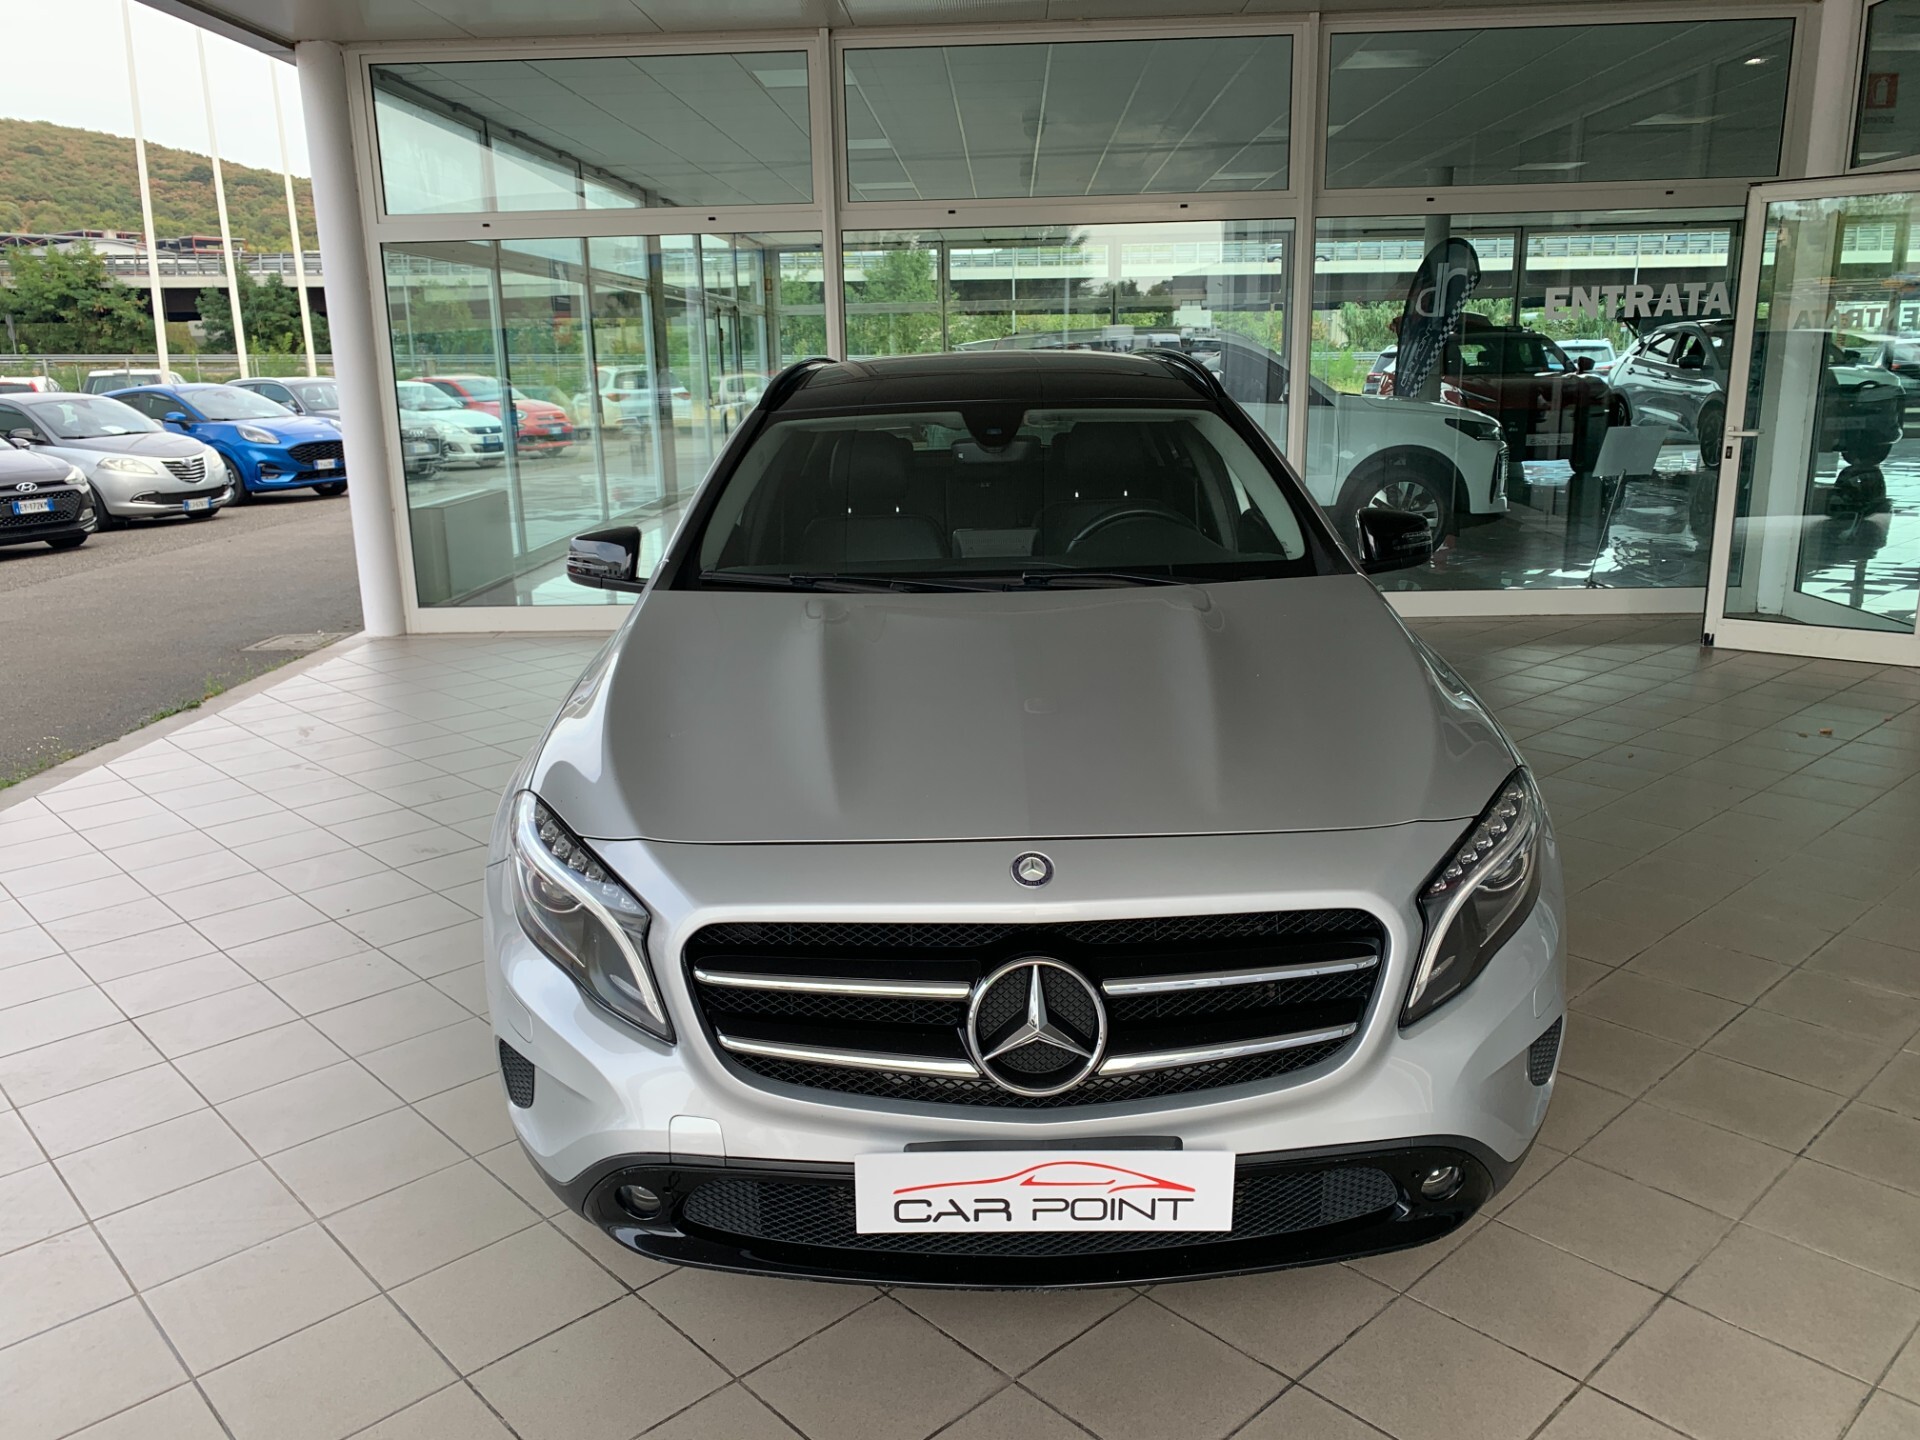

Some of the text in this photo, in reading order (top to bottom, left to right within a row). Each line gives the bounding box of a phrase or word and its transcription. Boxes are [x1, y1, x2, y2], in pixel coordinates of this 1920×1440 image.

[1544, 282, 1732, 320] ENTRATA
[893, 1197, 1195, 1223] CAR POINT
